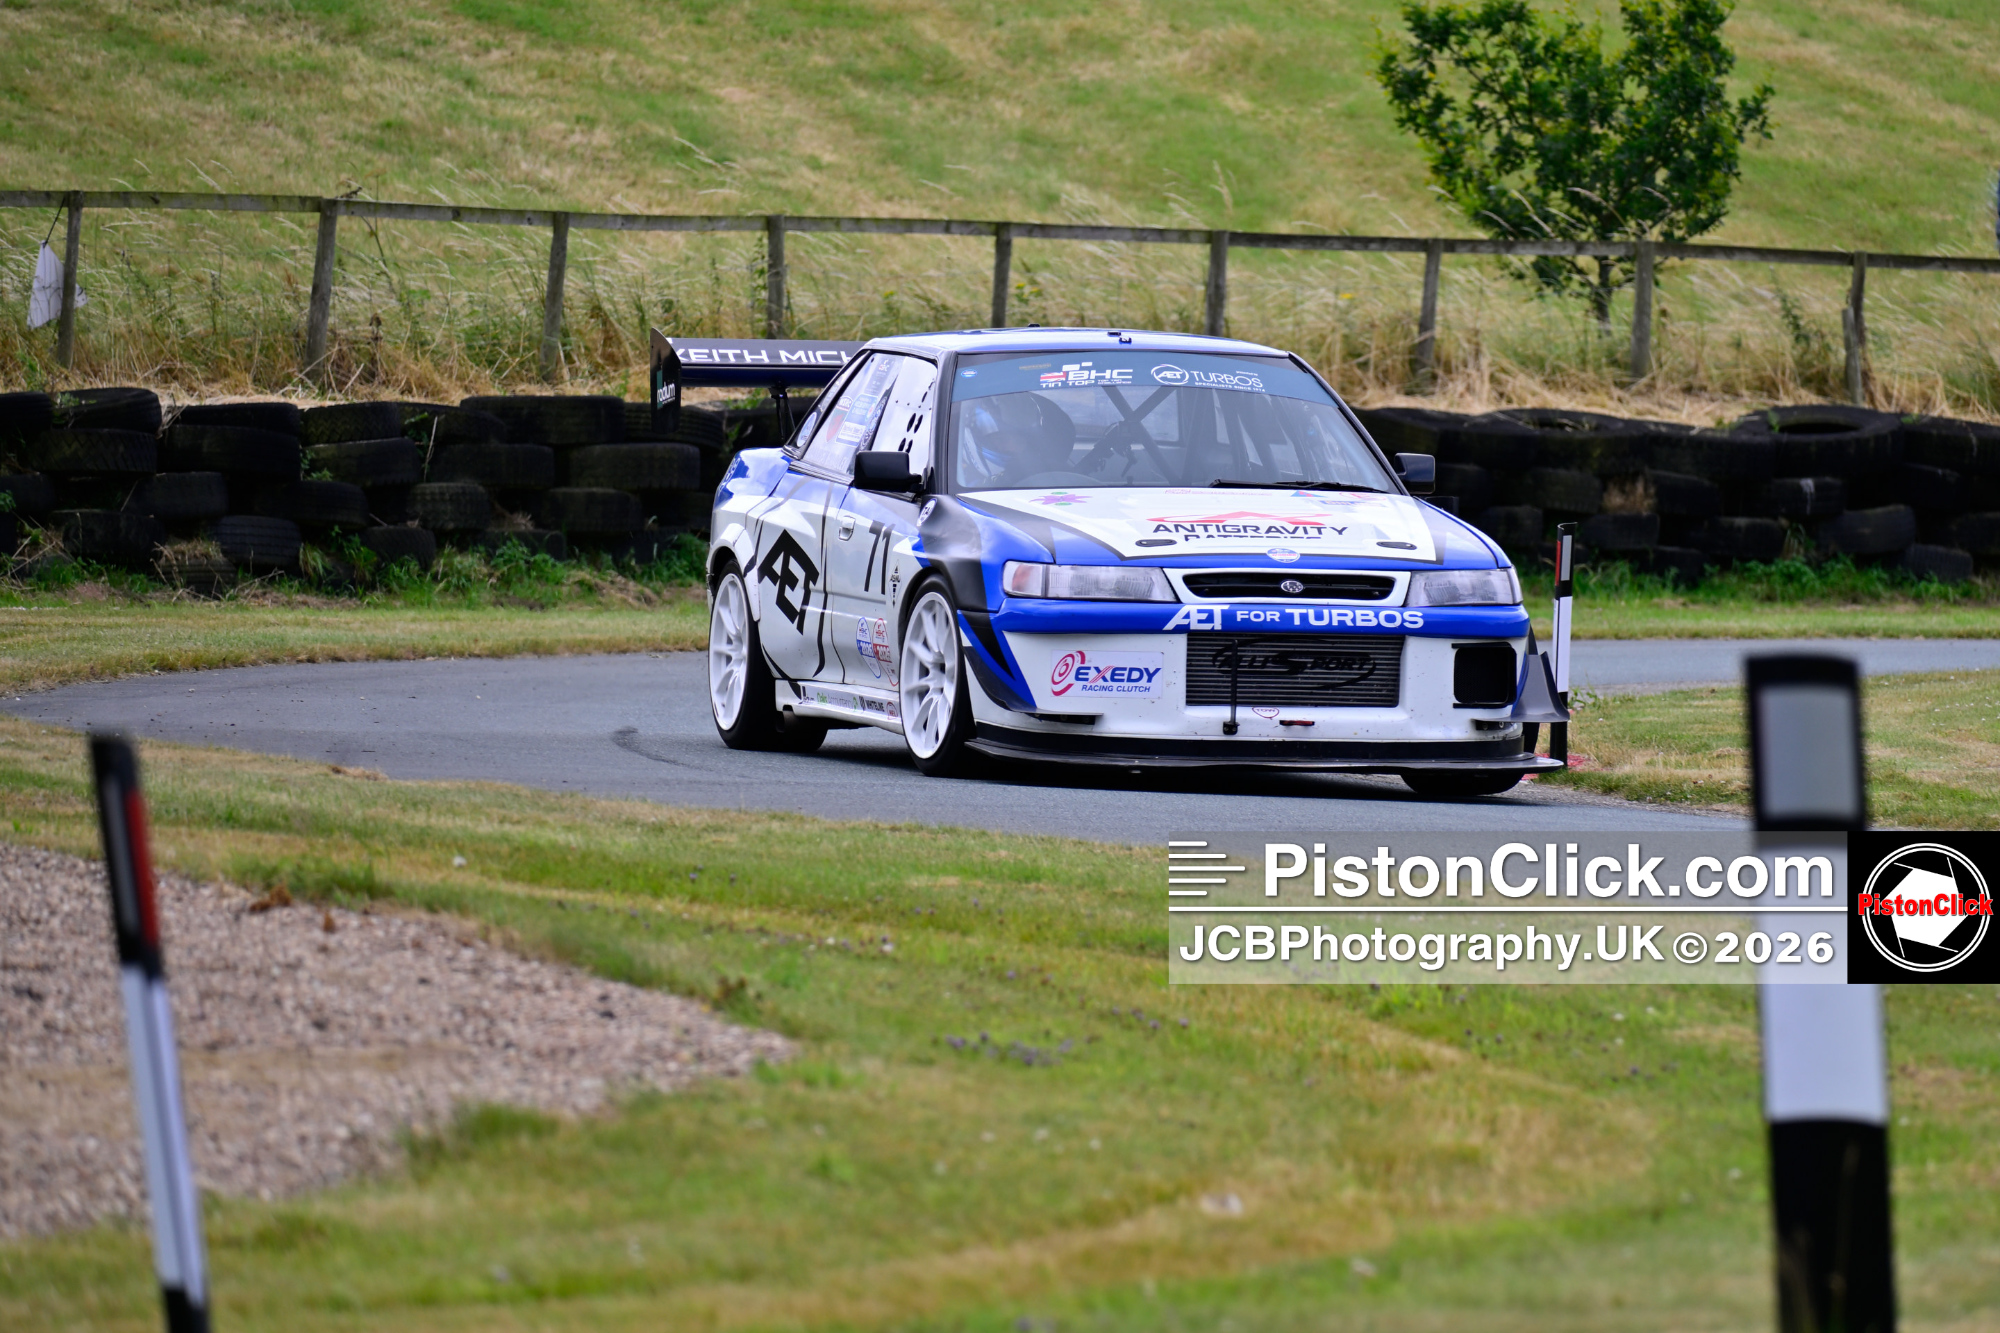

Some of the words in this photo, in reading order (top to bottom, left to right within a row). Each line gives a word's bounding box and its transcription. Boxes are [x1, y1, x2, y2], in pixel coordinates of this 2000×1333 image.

[1068, 369, 1134, 381] BHC
[1190, 370, 1264, 388] TURBOS
[1067, 379, 1095, 387] TOP
[1152, 523, 1349, 536] ANTIGRAVITY
[1236, 610, 1281, 622] FOR
[1285, 608, 1425, 629] TURBOS
[1074, 665, 1162, 683] EXEDY
[1081, 684, 1114, 692] RACING
[1116, 685, 1151, 693] CLUTCH
